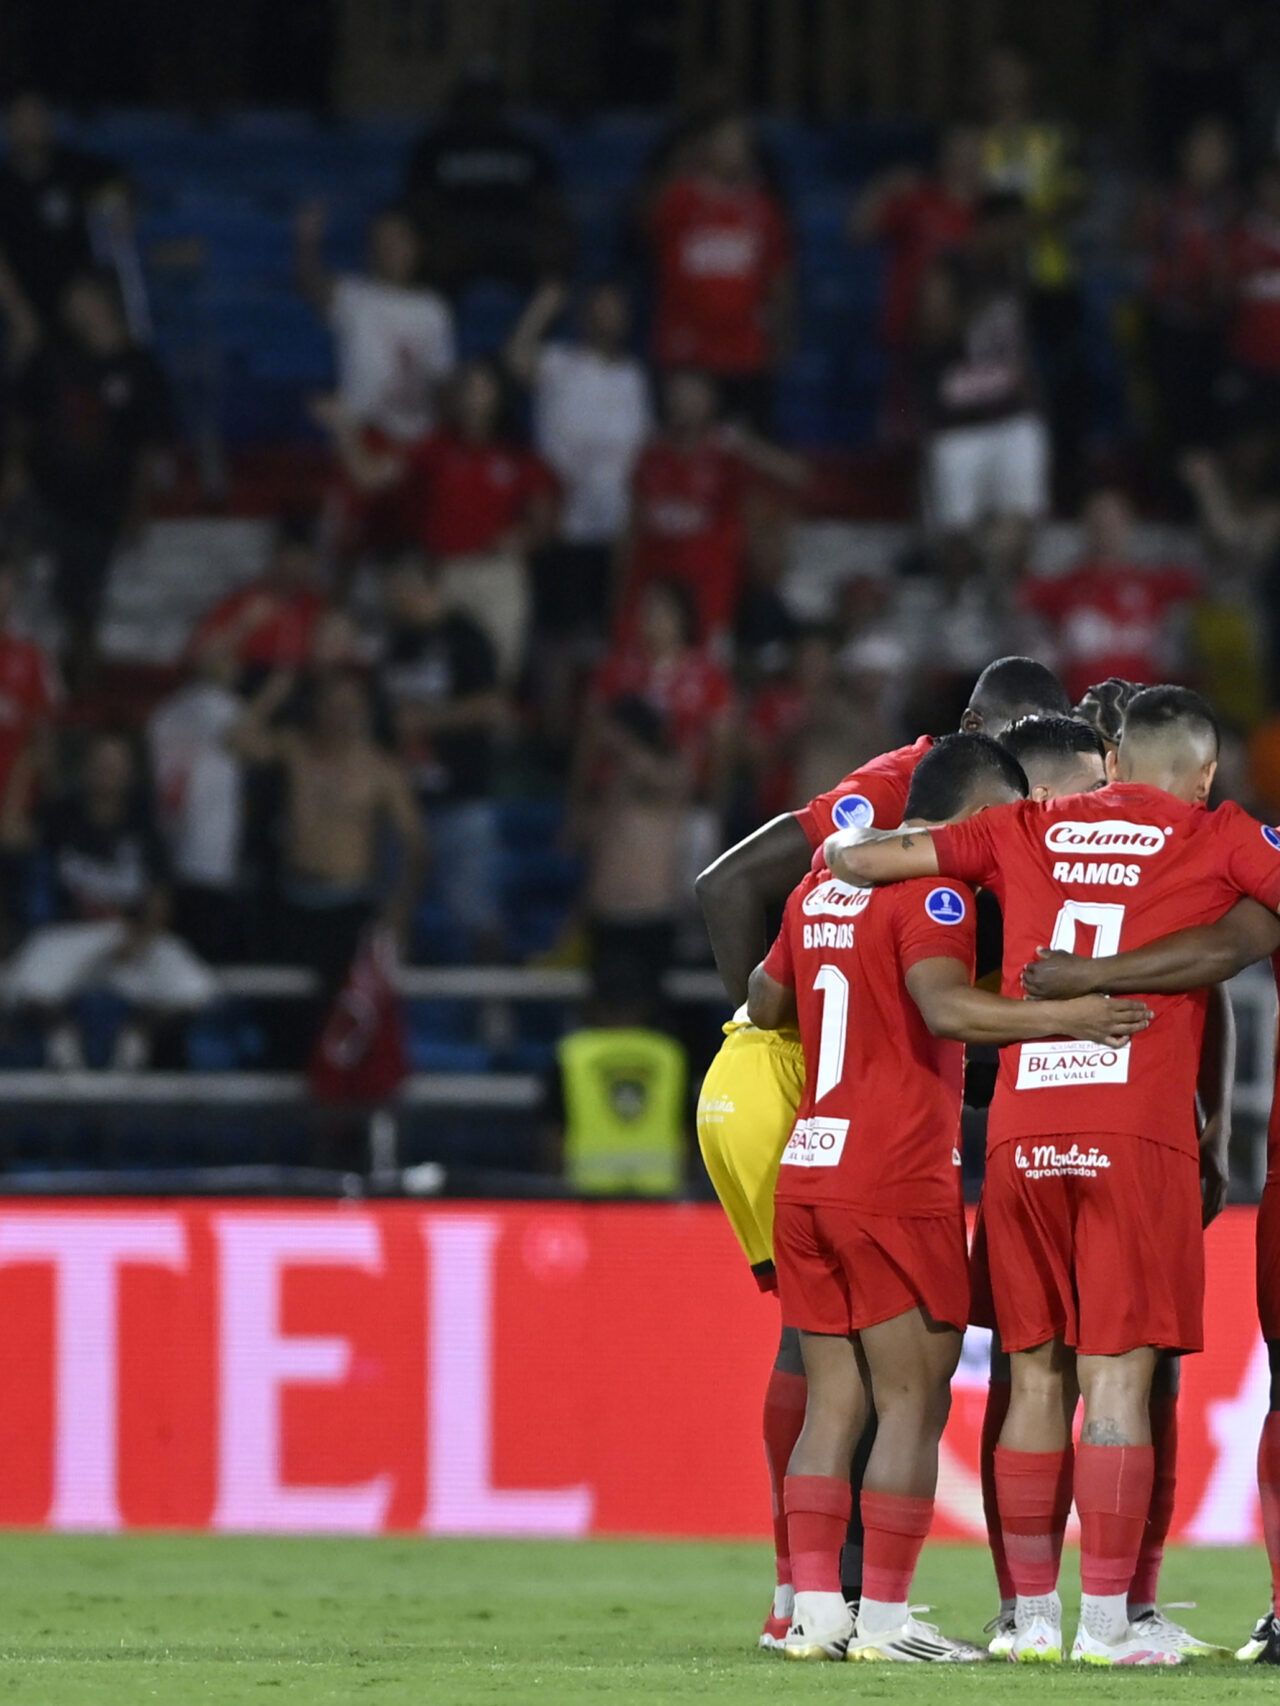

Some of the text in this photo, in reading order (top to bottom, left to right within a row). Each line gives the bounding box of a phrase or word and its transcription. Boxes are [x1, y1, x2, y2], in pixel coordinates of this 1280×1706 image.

[1050, 827, 1160, 848] Colanta
[1052, 861, 1142, 887] RAMOS
[805, 886, 871, 907] Clanta
[1028, 1050, 1118, 1073] BLANCO
[1040, 1070, 1096, 1082] DEL VALLE
[1031, 1143, 1112, 1168] Montaña
